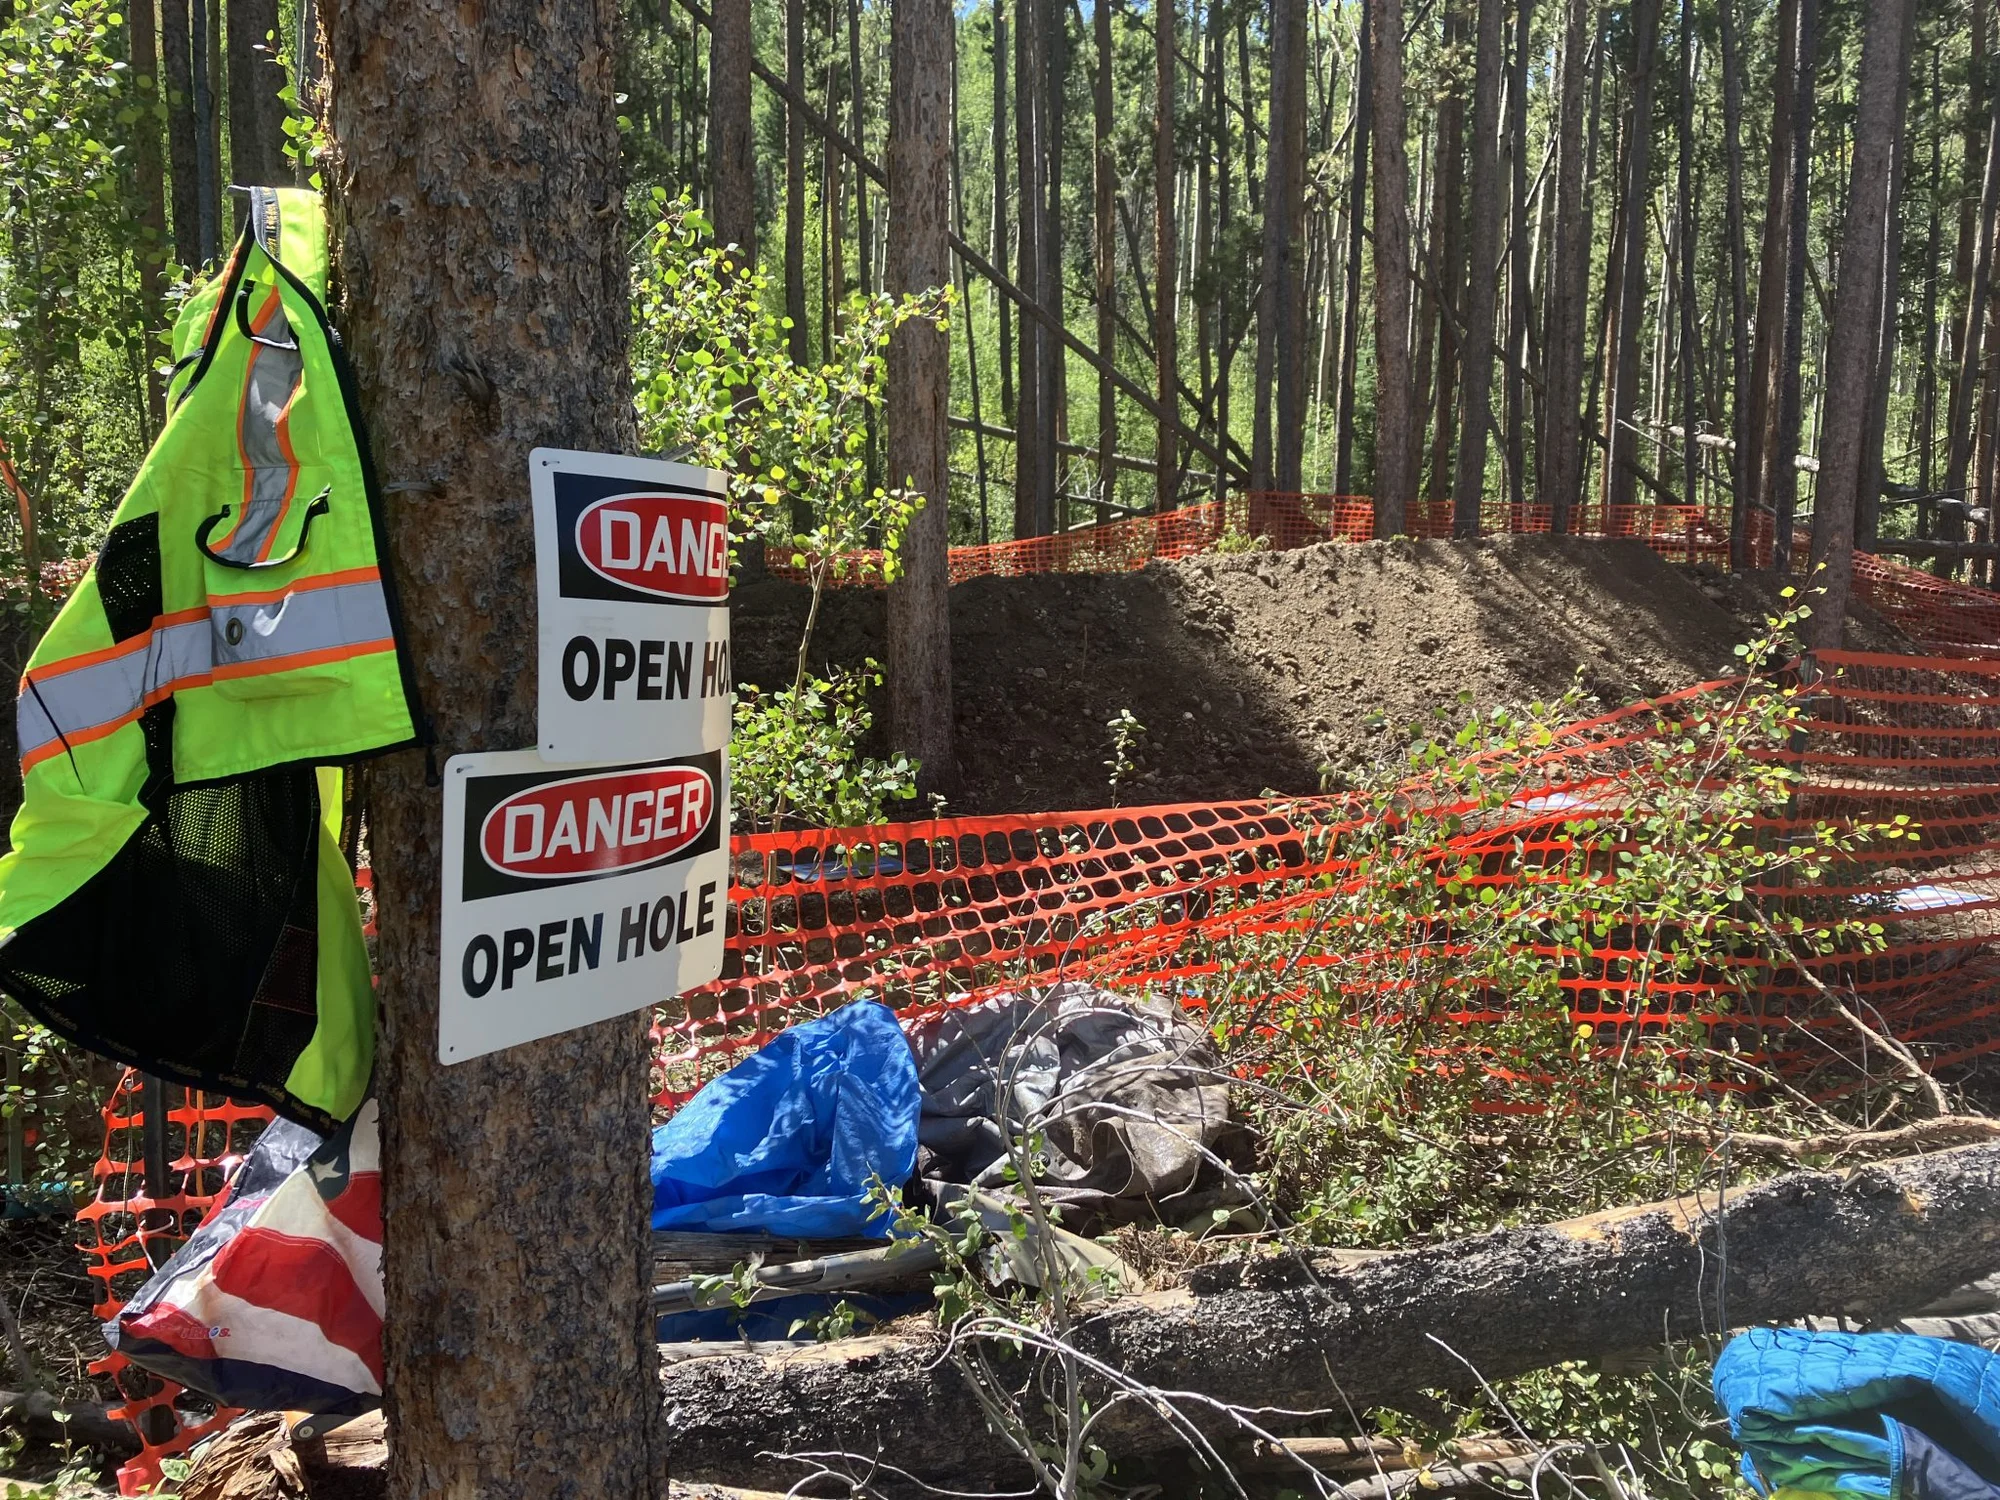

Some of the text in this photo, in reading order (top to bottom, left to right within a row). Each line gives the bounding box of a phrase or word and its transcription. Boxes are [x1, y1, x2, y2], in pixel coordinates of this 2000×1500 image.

[562, 635, 693, 702] OPEN
[502, 778, 705, 864] DANGER
[462, 881, 717, 999] OPEN HOLE
